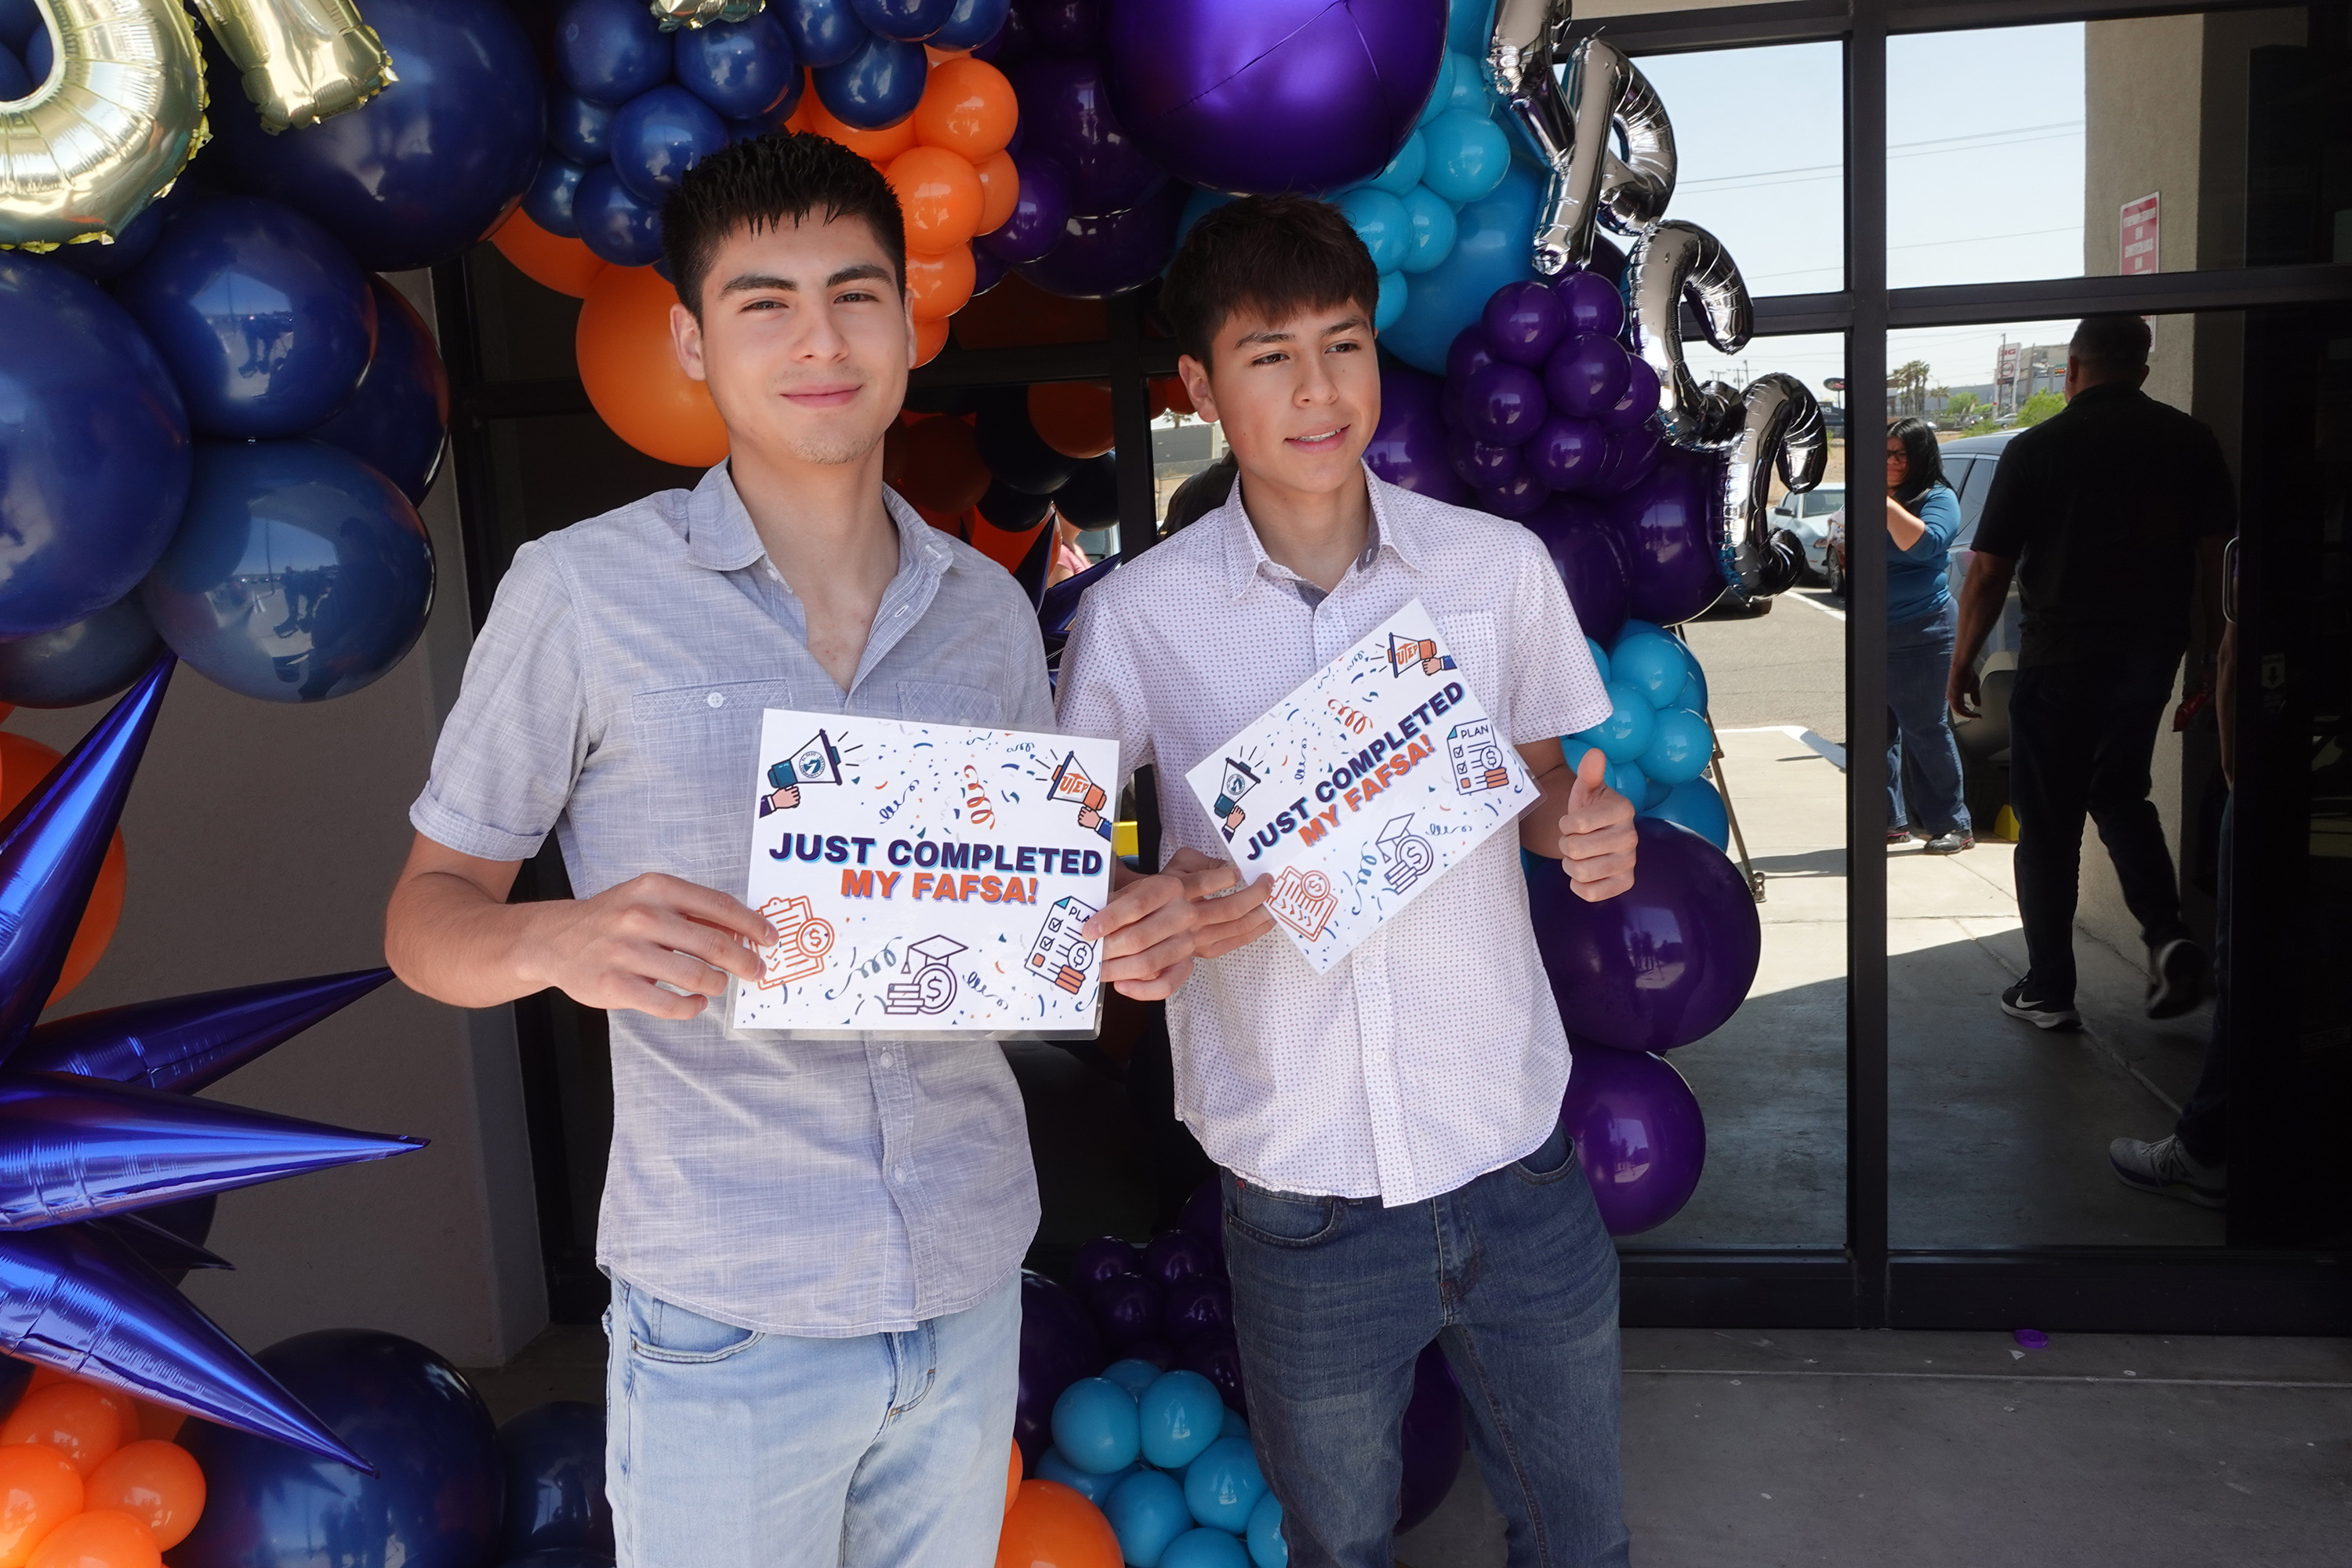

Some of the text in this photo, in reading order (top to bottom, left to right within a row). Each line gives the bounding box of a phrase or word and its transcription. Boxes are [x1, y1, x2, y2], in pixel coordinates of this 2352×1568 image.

[1396, 643, 1418, 665] UTEP
[1461, 724, 1490, 739] PLAN
[1060, 772, 1090, 794] UTEP
[1247, 681, 1465, 862] JUST COMPLETED
[1298, 734, 1437, 848] MY FAFSA!
[769, 832, 1104, 875] JUST COMPLETED
[840, 869, 1040, 905] MY FAFSA!
[1069, 906, 1091, 924] PLA
